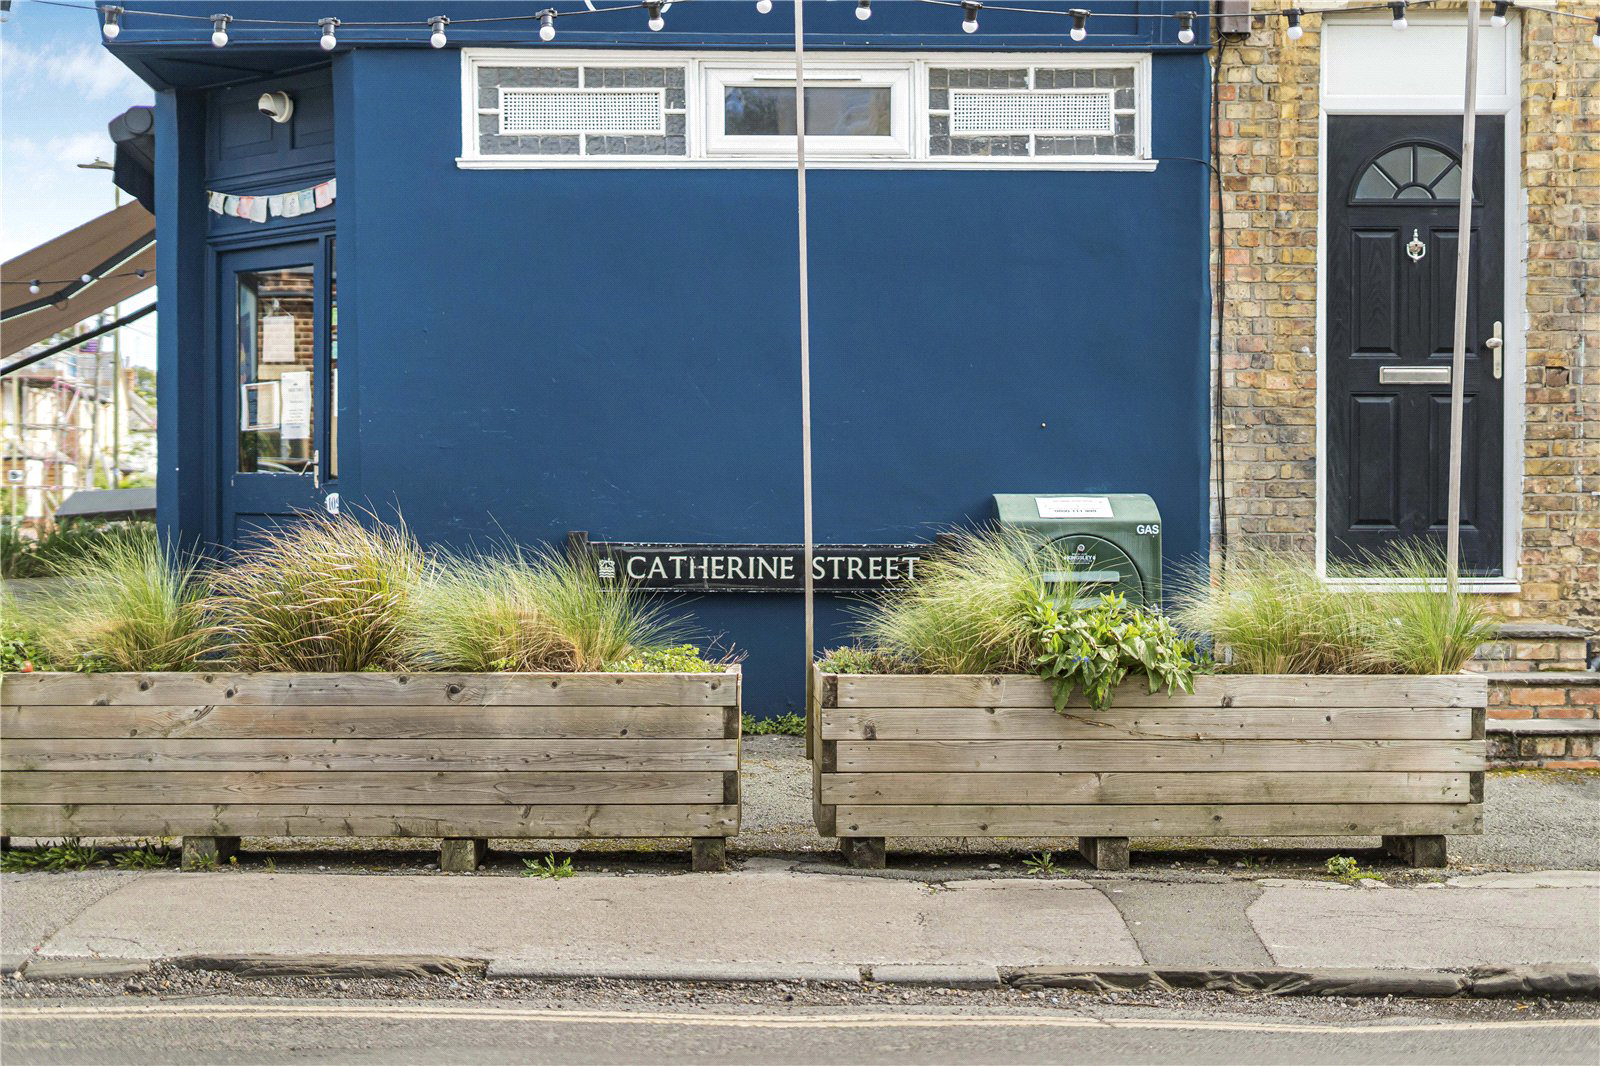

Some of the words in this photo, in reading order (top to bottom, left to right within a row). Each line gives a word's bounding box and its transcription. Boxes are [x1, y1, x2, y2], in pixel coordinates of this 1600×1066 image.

[1136, 524, 1159, 535] GAS
[626, 555, 796, 580] CATHERINE
[812, 556, 921, 580] STREET
